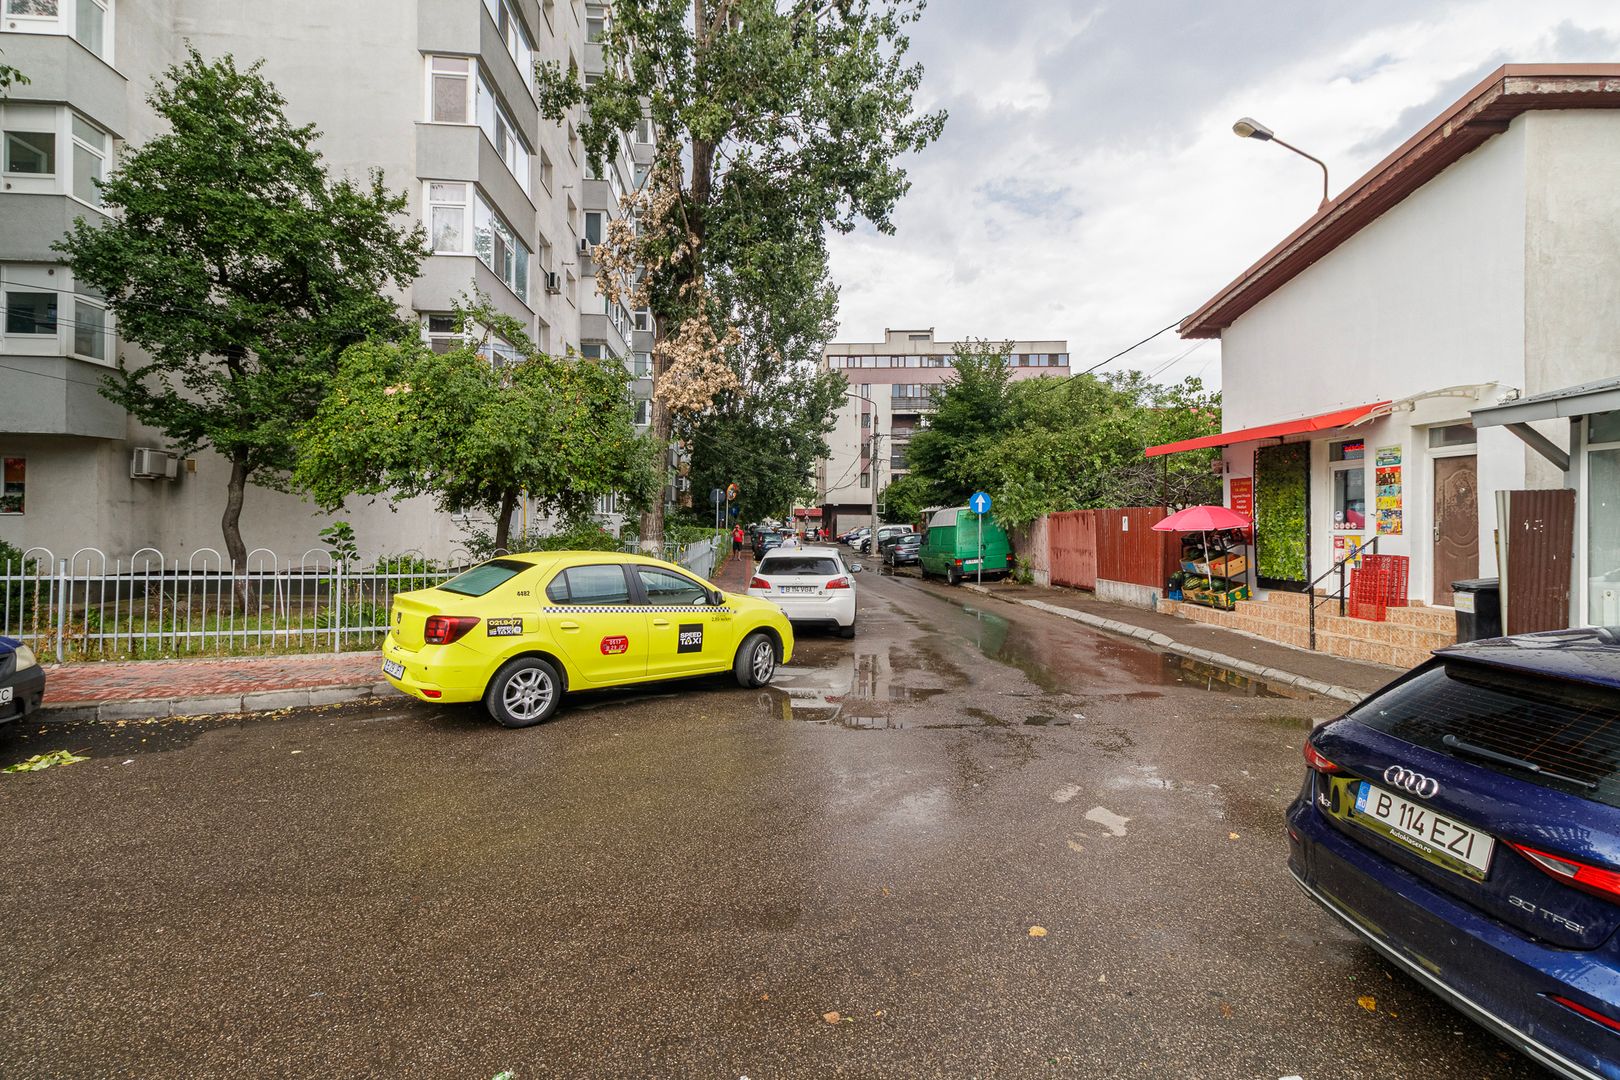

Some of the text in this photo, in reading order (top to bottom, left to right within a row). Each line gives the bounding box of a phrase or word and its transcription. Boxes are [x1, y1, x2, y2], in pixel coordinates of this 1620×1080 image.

[680, 637, 702, 645] TAXI
[1376, 793, 1476, 860] B 114 EZI
[1389, 828, 1432, 854] Autoklasen.ro
[1508, 895, 1536, 913] 30
